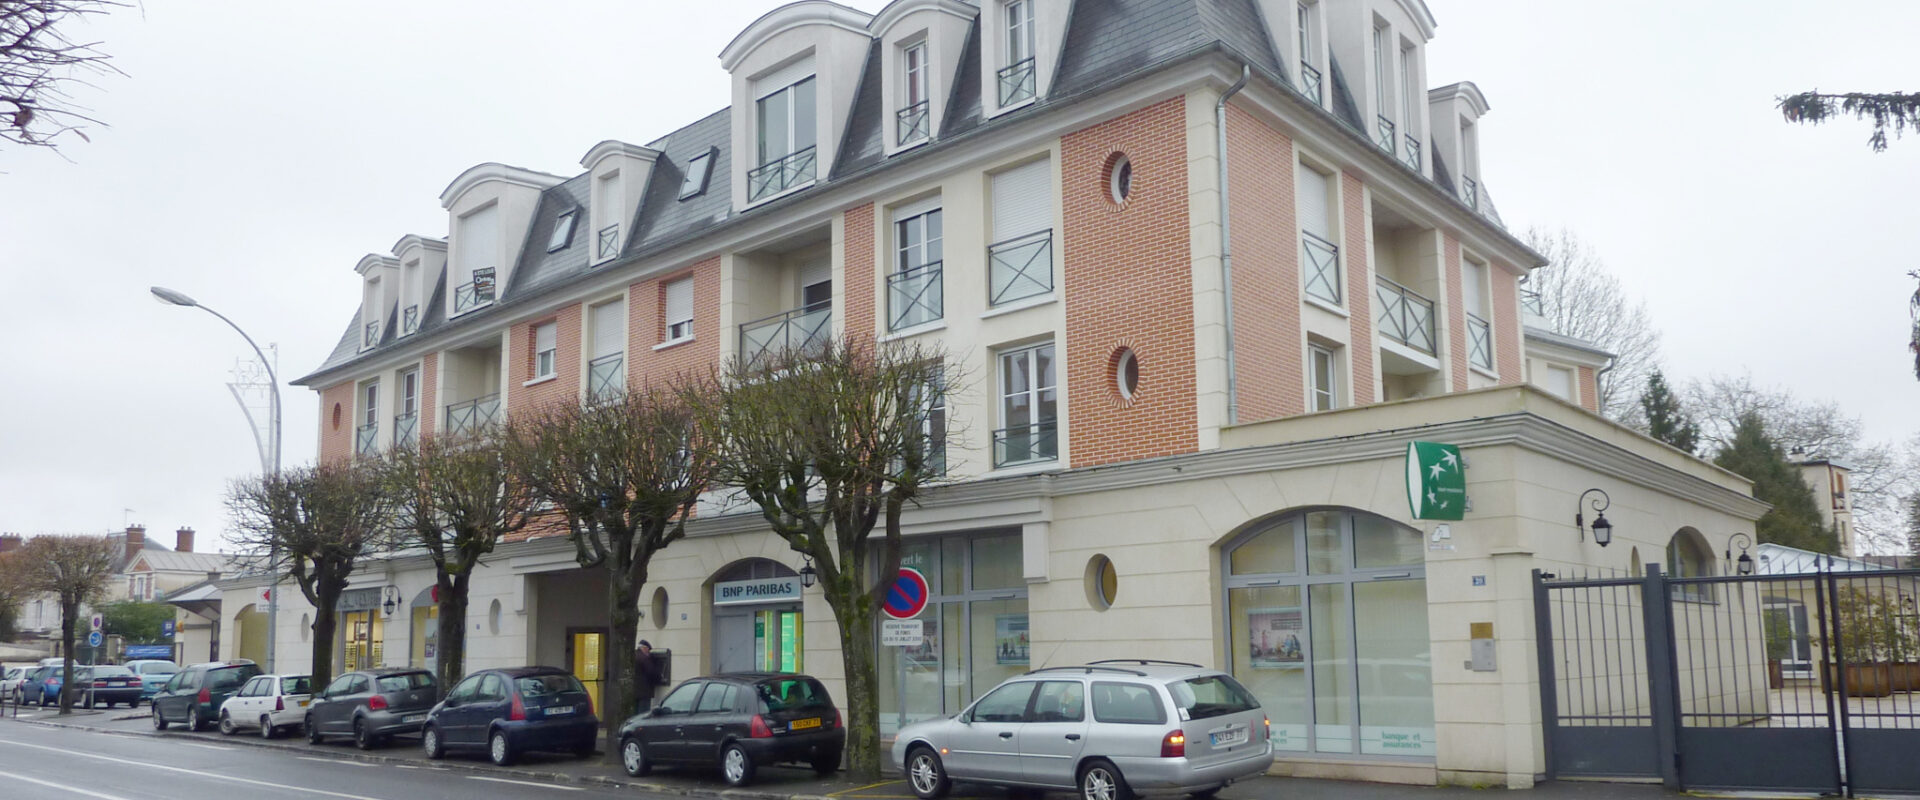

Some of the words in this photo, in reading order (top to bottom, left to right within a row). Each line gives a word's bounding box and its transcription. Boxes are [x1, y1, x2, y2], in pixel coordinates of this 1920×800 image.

[722, 586, 744, 598] BNP
[746, 582, 792, 596] PARIBAS
[1382, 731, 1408, 741] banque
[1413, 732, 1420, 740] et
